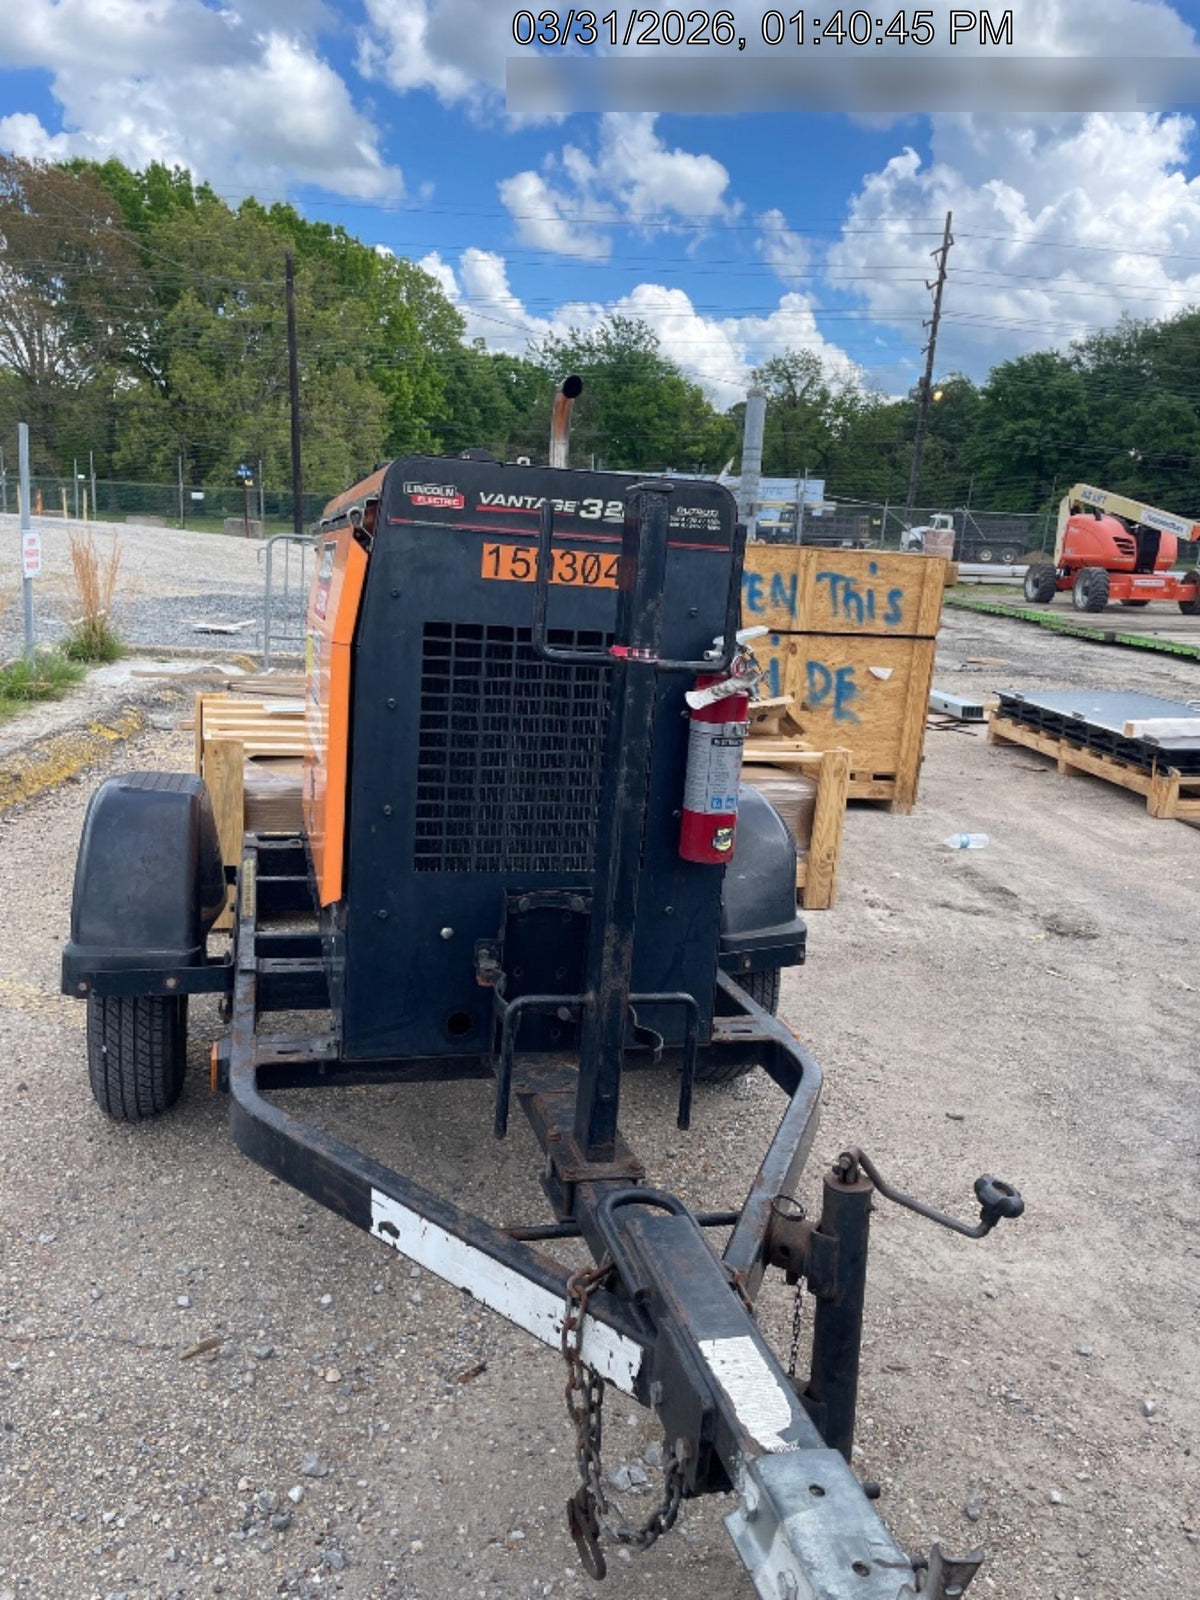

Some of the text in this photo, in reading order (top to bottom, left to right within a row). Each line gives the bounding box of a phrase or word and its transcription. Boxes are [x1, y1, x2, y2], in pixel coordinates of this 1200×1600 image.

[406, 483, 455, 497] LINCOLN
[416, 495, 461, 506] ELECTRIC
[479, 491, 625, 521] VANTAGE 32
[742, 570, 798, 619] EN
